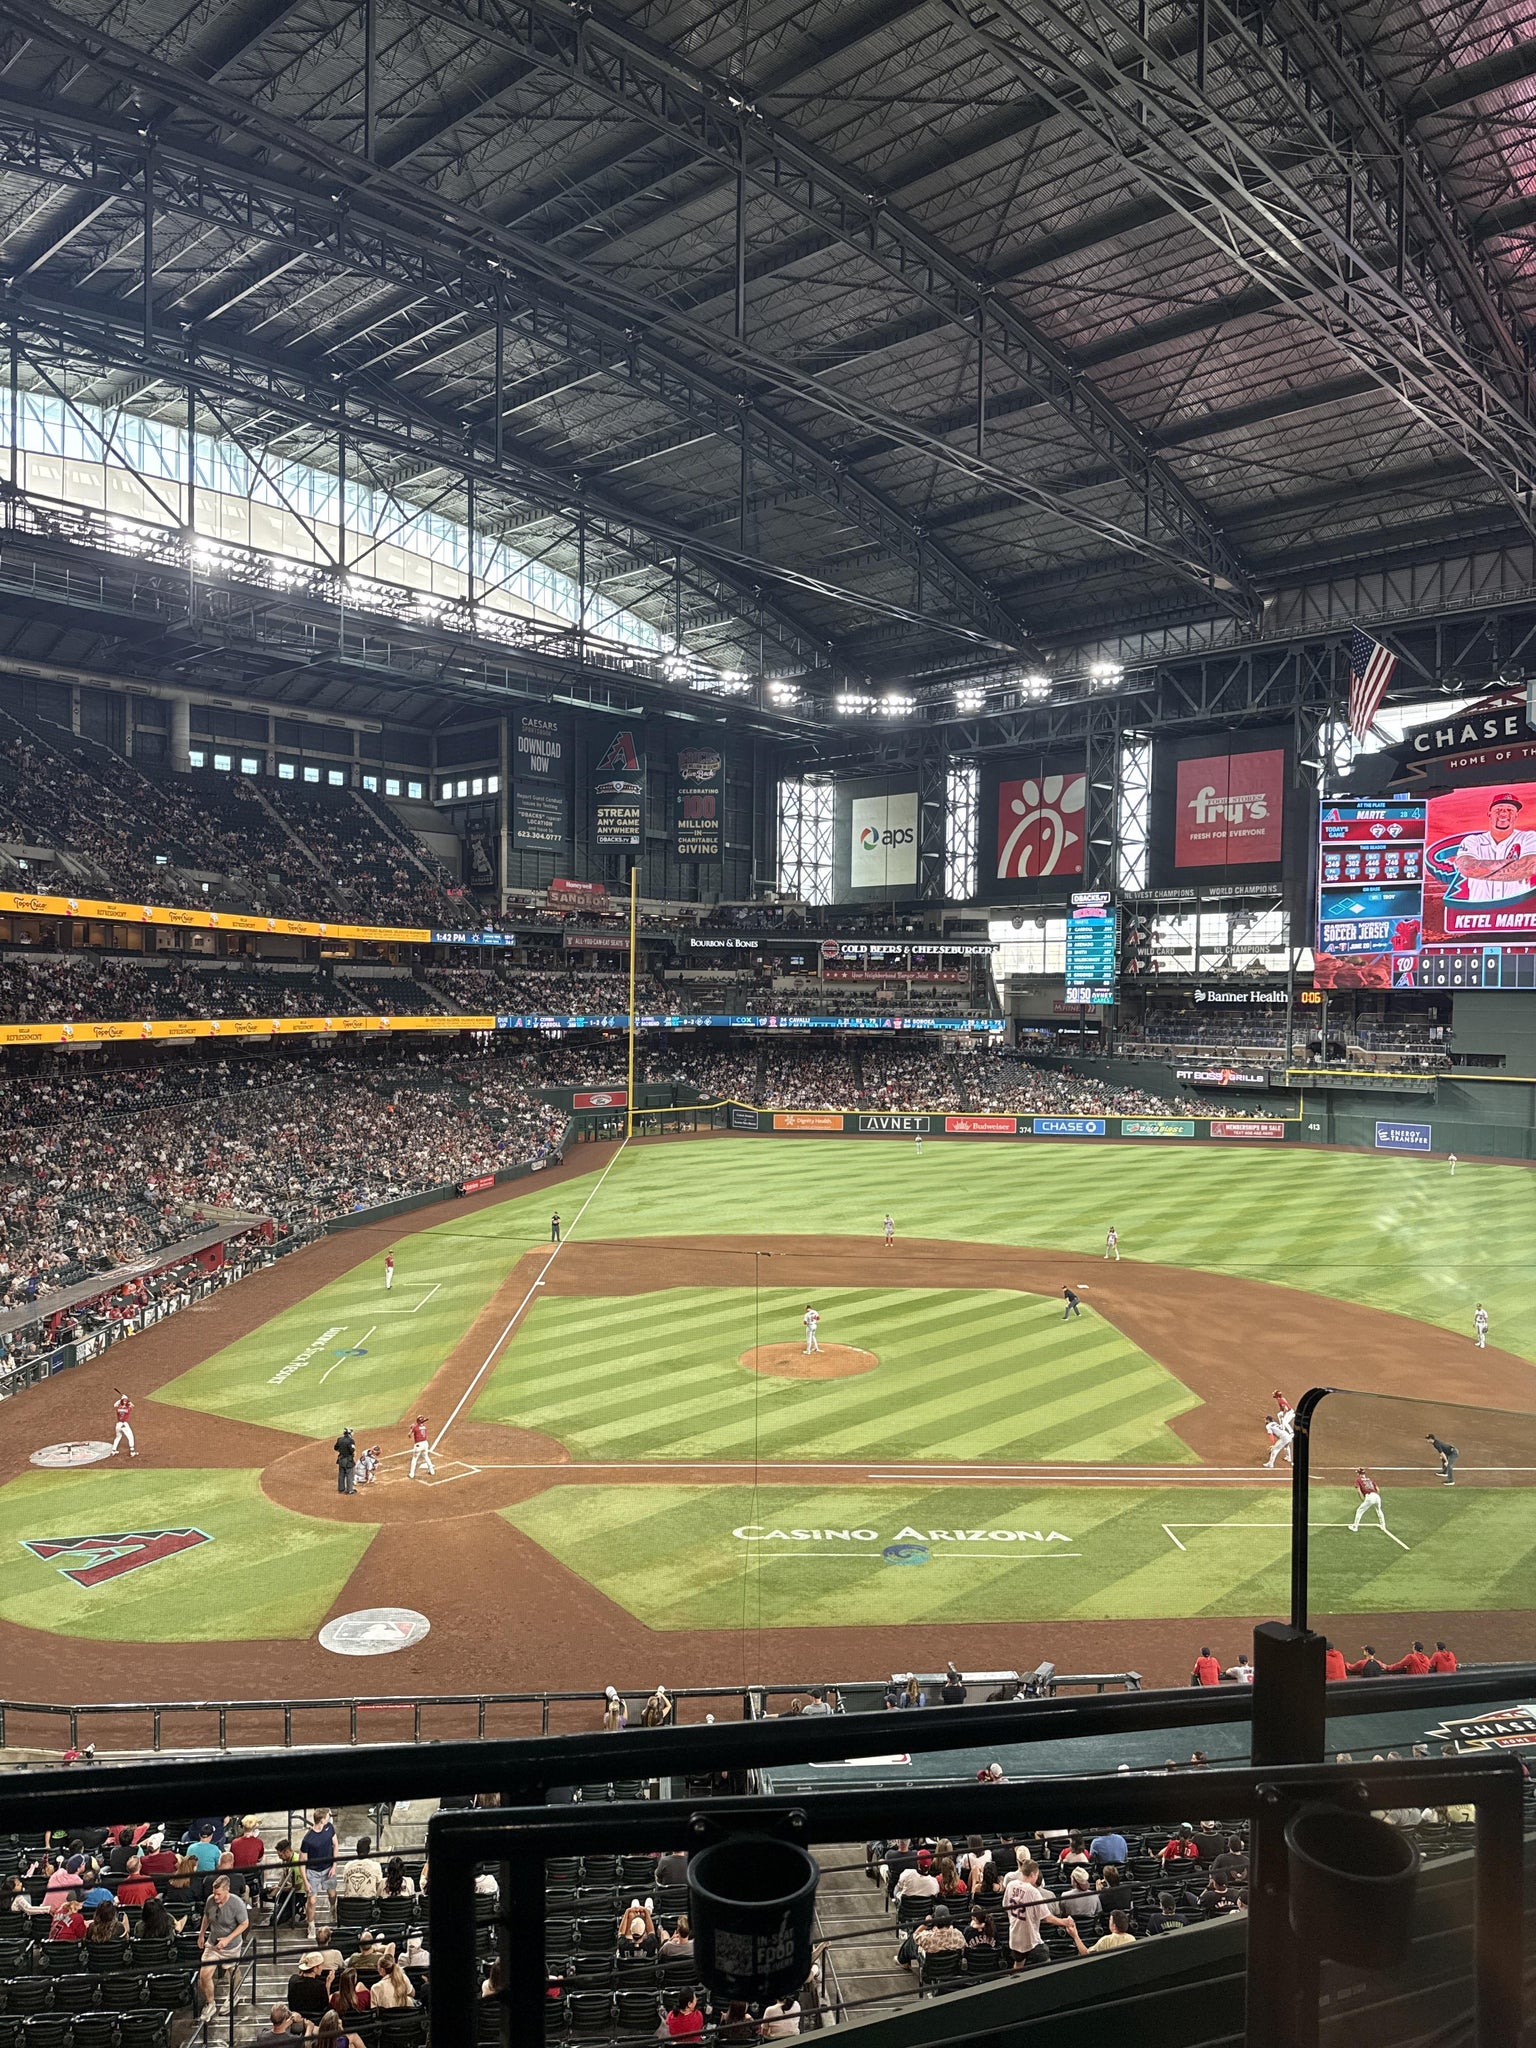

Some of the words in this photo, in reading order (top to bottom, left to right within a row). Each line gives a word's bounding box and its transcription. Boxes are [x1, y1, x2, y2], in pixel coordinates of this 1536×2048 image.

[522, 717, 557, 731] CAESARS
[1414, 716, 1517, 751] CHASE
[518, 735, 561, 759] DOWNLOAD
[531, 755, 549, 773] NOW
[1451, 756, 1485, 768] HOME
[1496, 752, 1511, 760] OF
[597, 808, 639, 817] STREAM
[1356, 810, 1386, 819] MARTE
[518, 831, 561, 841] 623.304.0777
[882, 828, 913, 849] aps
[1190, 832, 1211, 840] FRESH
[1213, 831, 1227, 839] FOR
[1229, 828, 1265, 837] EVERYONE
[678, 845, 718, 854] GIVING
[566, 881, 592, 890] Honeywell
[1209, 887, 1233, 895] WORLD
[1235, 885, 1277, 894] CHAMPIONS
[1154, 889, 1194, 898] CHAMPIONS
[1455, 915, 1491, 928] KETEL
[1495, 913, 1536, 927] MARTE
[436, 933, 451, 941] 1:42
[453, 933, 466, 942] PM
[1324, 928, 1357, 942] SOCCER
[1358, 927, 1389, 939] JERSEY
[690, 938, 725, 947] BOURBON
[726, 939, 734, 947] &
[735, 939, 758, 948] BONES
[841, 945, 867, 953] COLD
[870, 945, 902, 953] BEERS
[904, 945, 910, 953] &
[912, 945, 998, 954] CHEESEBURGERS
[1225, 946, 1270, 954] CHAMPIONS
[1422, 960, 1430, 969] 0
[1440, 960, 1444, 968] 1
[1455, 960, 1462, 968] 0
[1471, 959, 1478, 968] 0
[1488, 959, 1495, 968] 0
[1423, 975, 1428, 984] 1
[1438, 975, 1445, 984] 0
[1454, 975, 1461, 984] 0
[1472, 975, 1477, 983] 1
[1067, 987, 1078, 999] 50
[1080, 987, 1091, 999] 50
[1208, 991, 1248, 1003] Banner
[1251, 991, 1288, 1003] Health
[1302, 992, 1321, 1003] 0:06
[1176, 1071, 1193, 1079] PIT
[1194, 1071, 1223, 1080] BOSS
[1228, 1073, 1264, 1083] GRILLS
[867, 1117, 923, 1129] AVNET
[972, 1122, 1010, 1131] Budweiser
[1042, 1122, 1084, 1131] CHASE
[1308, 1123, 1320, 1131] 413
[1019, 1126, 1032, 1134] 374
[1391, 1129, 1420, 1138] ENERGY
[1391, 1135, 1428, 1144] TRANSFER
[1460, 1720, 1536, 1737] CHASE
[1012, 1887, 1026, 1900] SOTO
[757, 1940, 794, 1963] FOOD
